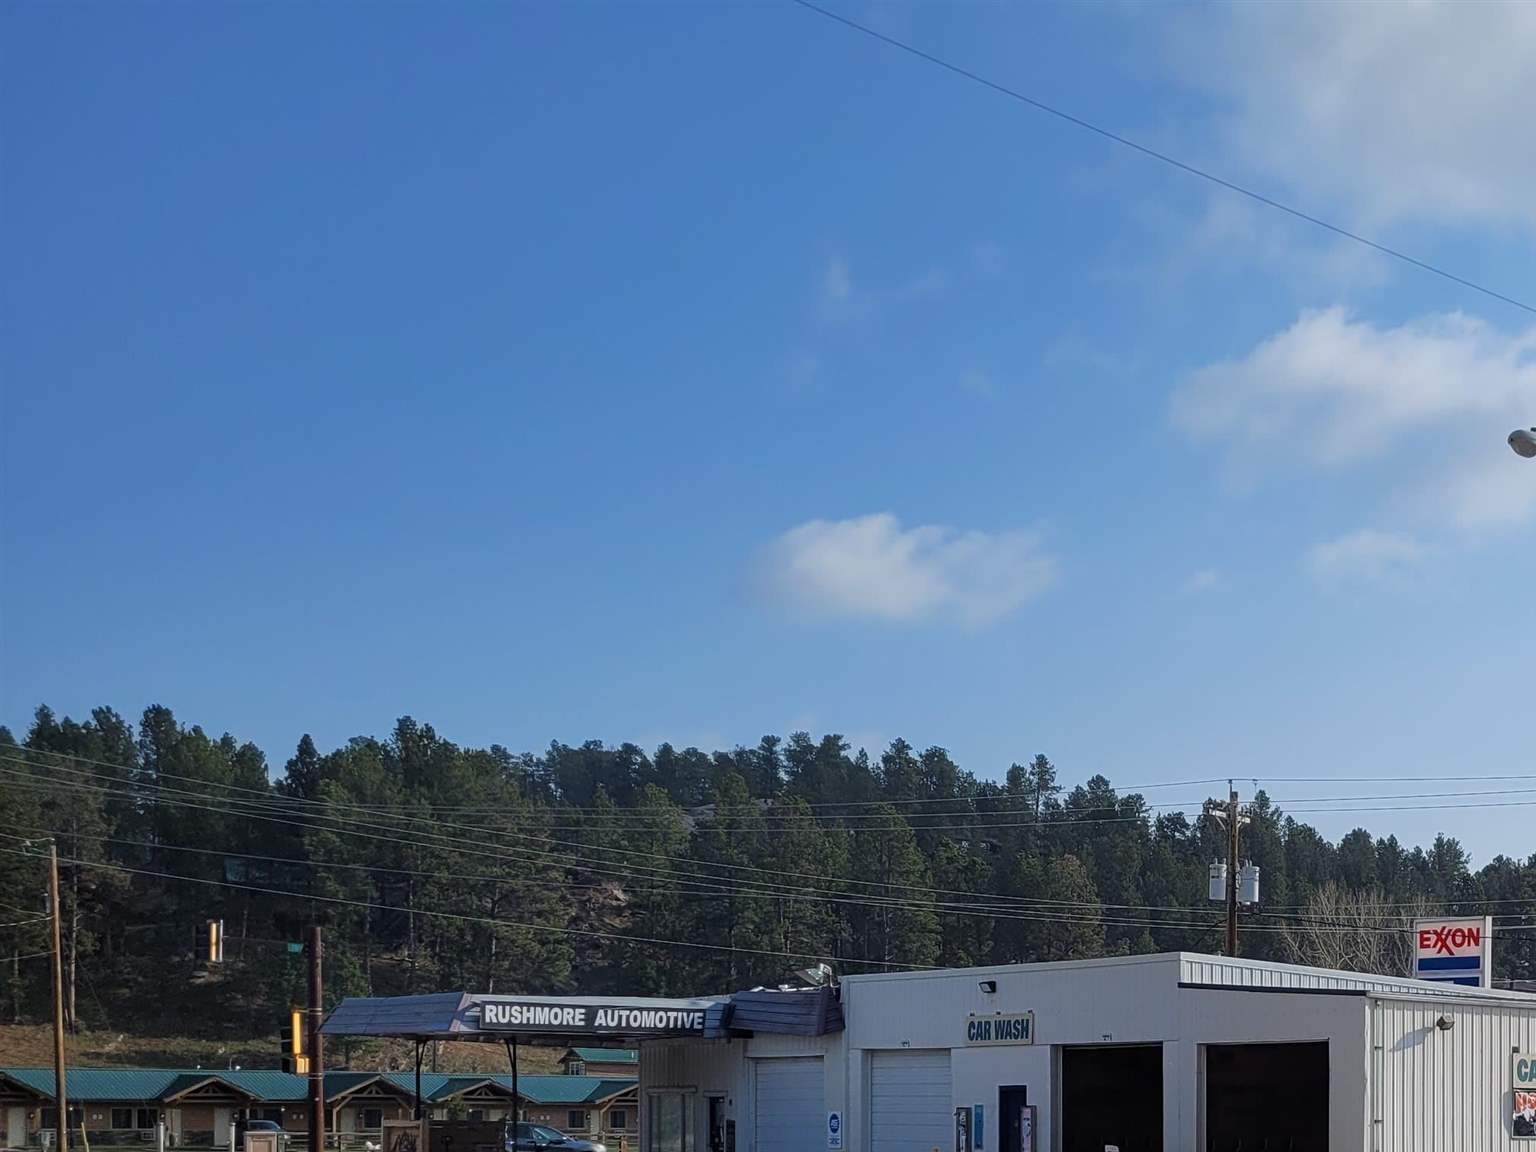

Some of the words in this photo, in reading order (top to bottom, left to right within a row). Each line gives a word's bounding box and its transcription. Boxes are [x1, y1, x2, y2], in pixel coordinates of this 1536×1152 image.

[1419, 926, 1480, 955] EXXON
[485, 1005, 585, 1026] RUSHMORE
[594, 1009, 703, 1029] AUTOMOTIVE
[967, 1020, 992, 1041] CAR
[994, 1019, 1029, 1040] WASH
